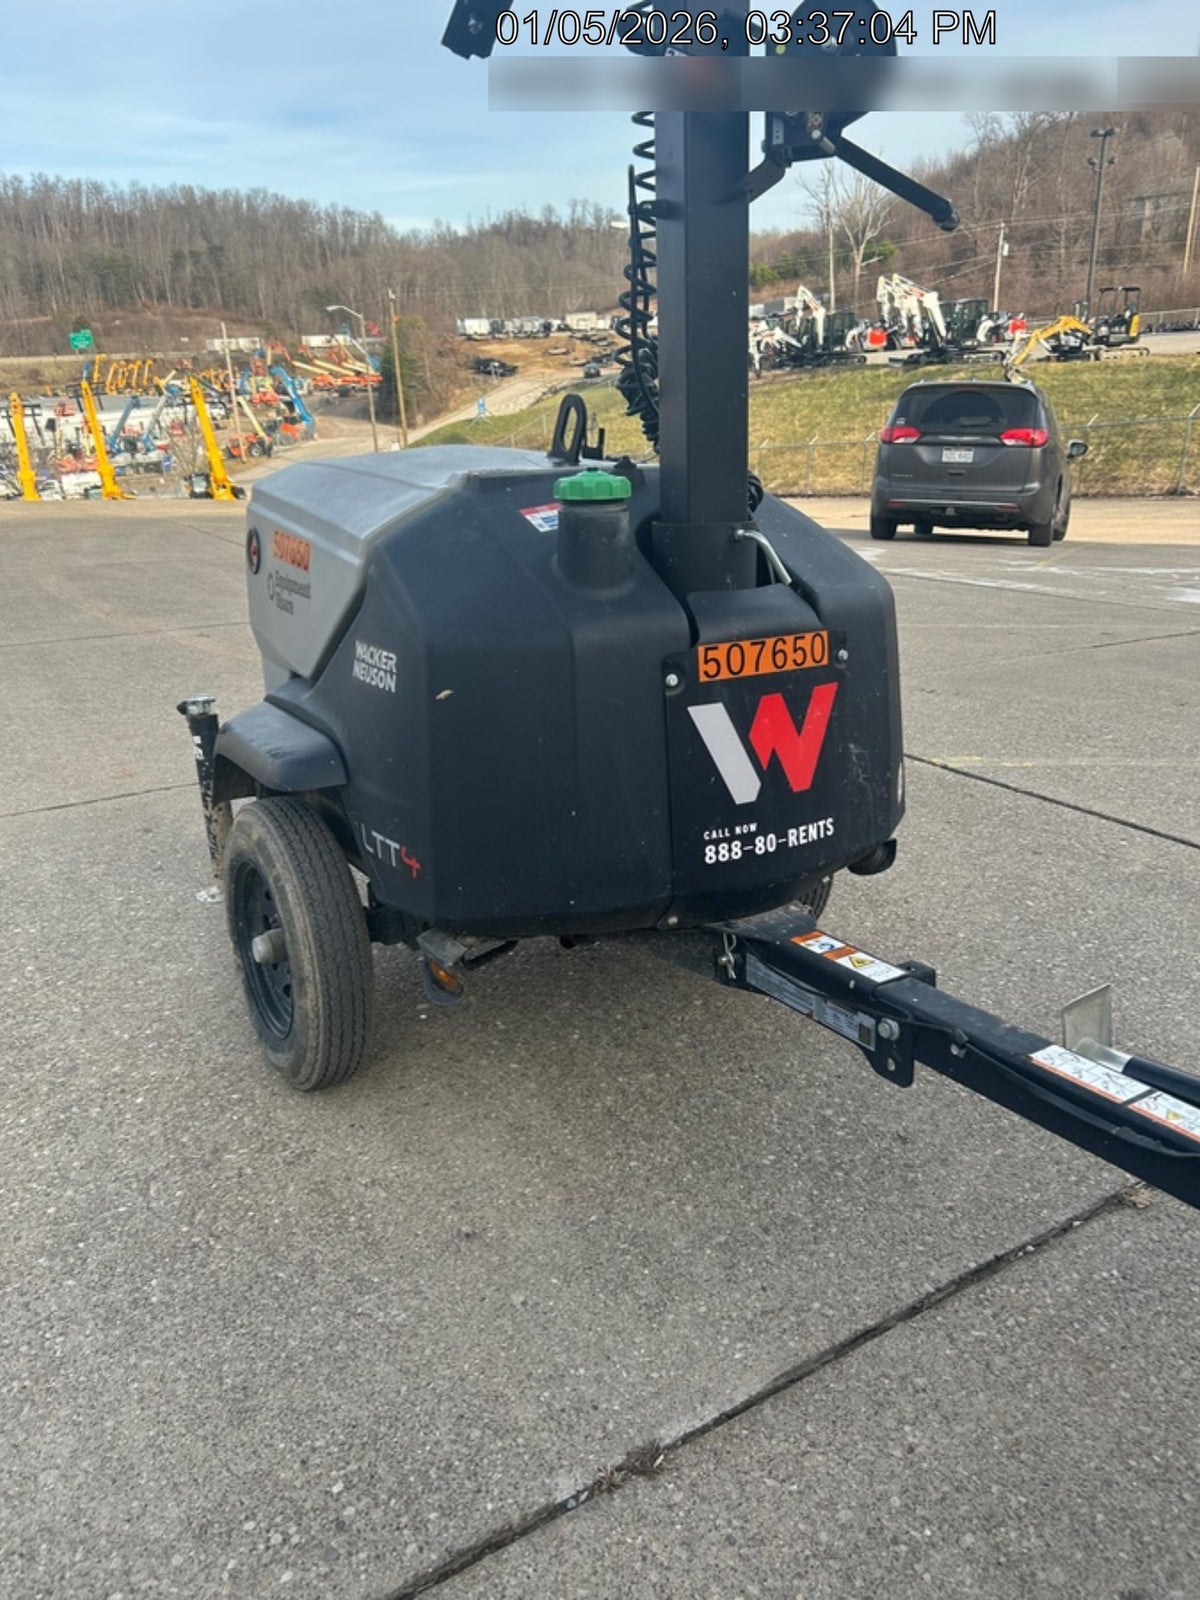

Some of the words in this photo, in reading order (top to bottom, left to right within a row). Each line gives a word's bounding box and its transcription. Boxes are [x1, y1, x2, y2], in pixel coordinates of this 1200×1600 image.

[355, 640, 397, 673] WACKER
[703, 632, 825, 679] 507650
[352, 660, 396, 693] NEUSON
[703, 828, 730, 840] CALL
[735, 823, 758, 835] NOW
[705, 817, 834, 864] 888-80-RENTS
